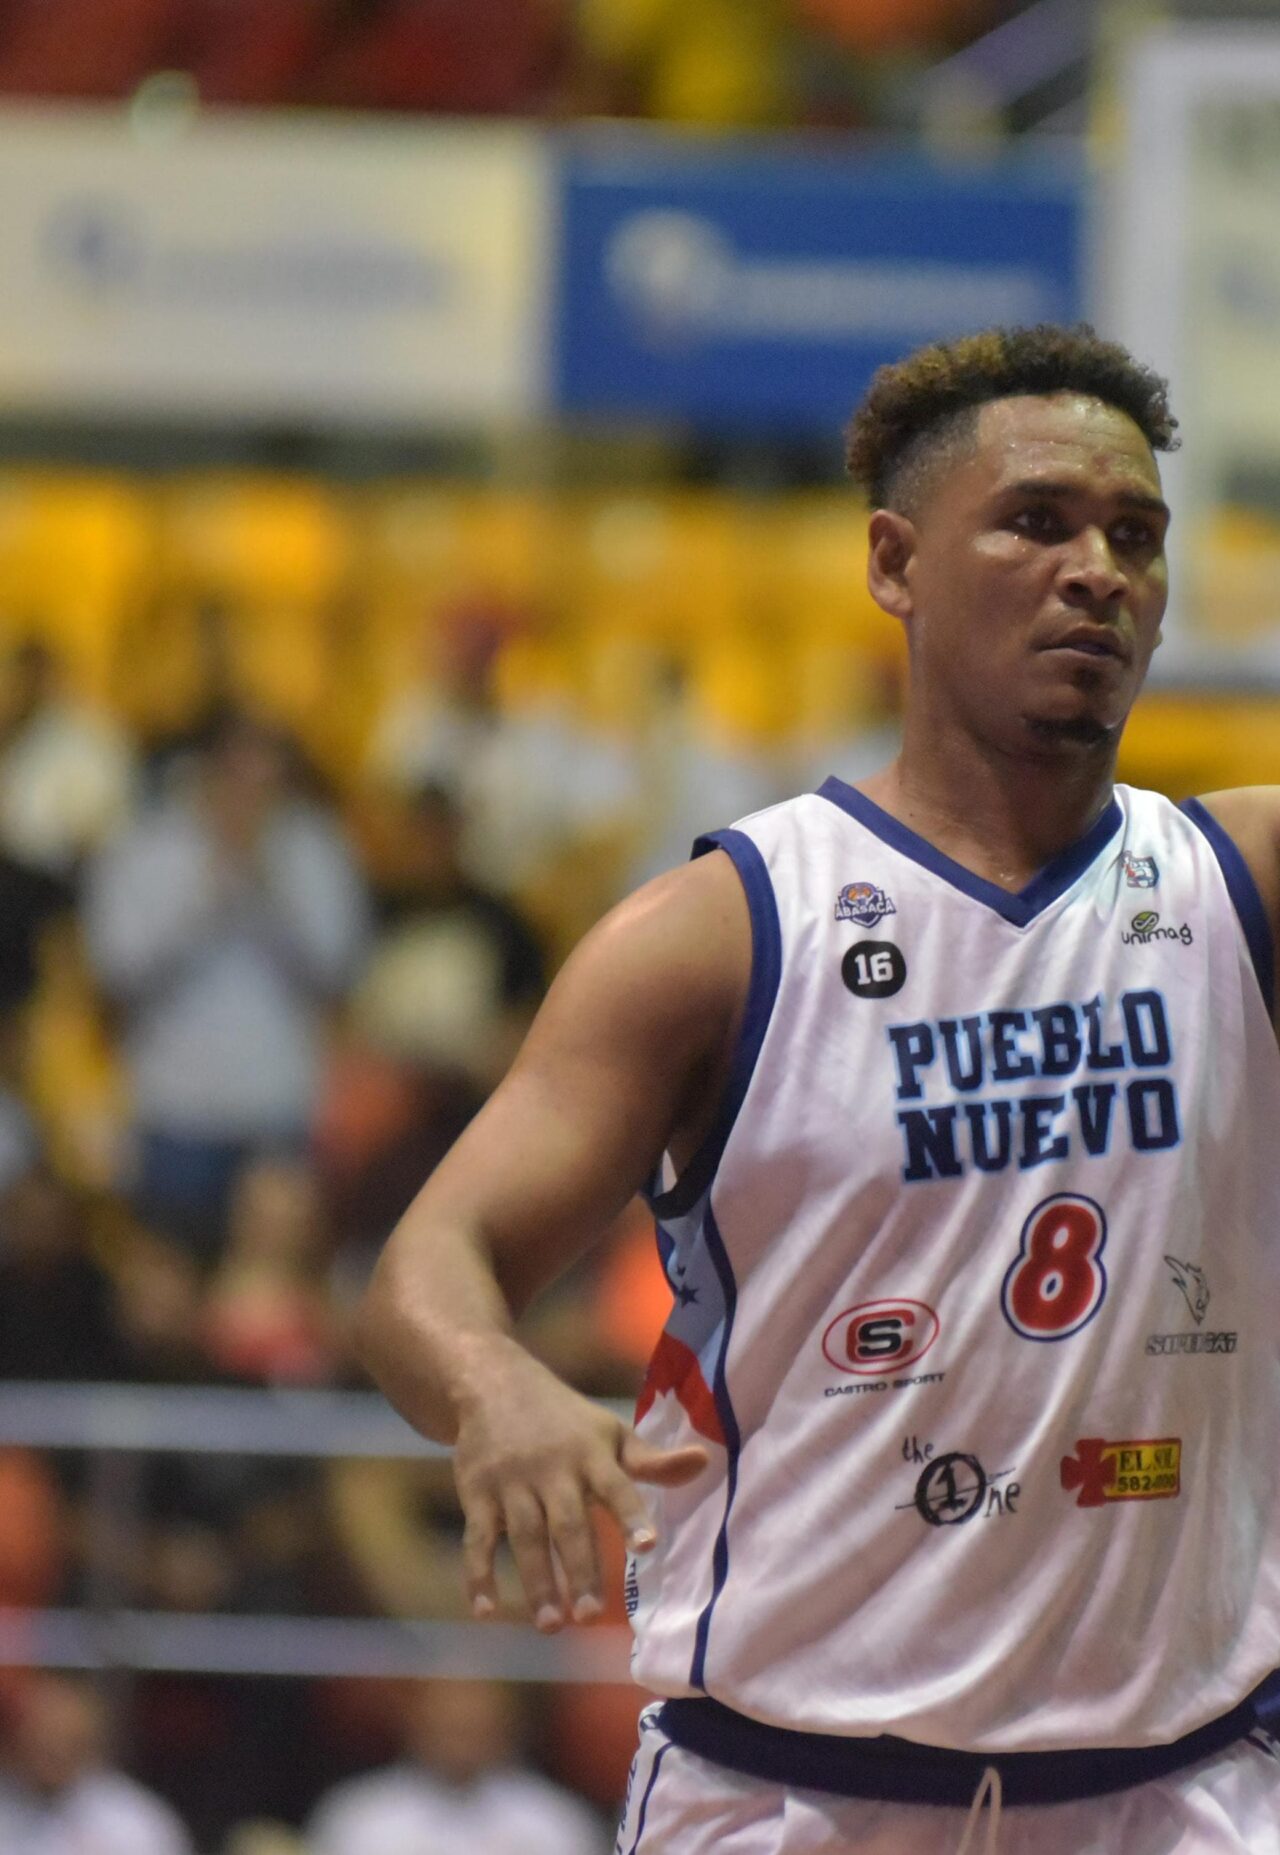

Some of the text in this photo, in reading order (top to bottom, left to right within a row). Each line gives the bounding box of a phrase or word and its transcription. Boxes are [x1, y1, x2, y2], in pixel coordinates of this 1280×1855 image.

[855, 951, 894, 986] 16
[887, 988, 1173, 1099] PUEBLO
[898, 1077, 1181, 1182] NUEVO
[1000, 1191, 1108, 1343] 8
[824, 1372, 946, 1398] CASTRO SPORT
[902, 1436, 934, 1463] the
